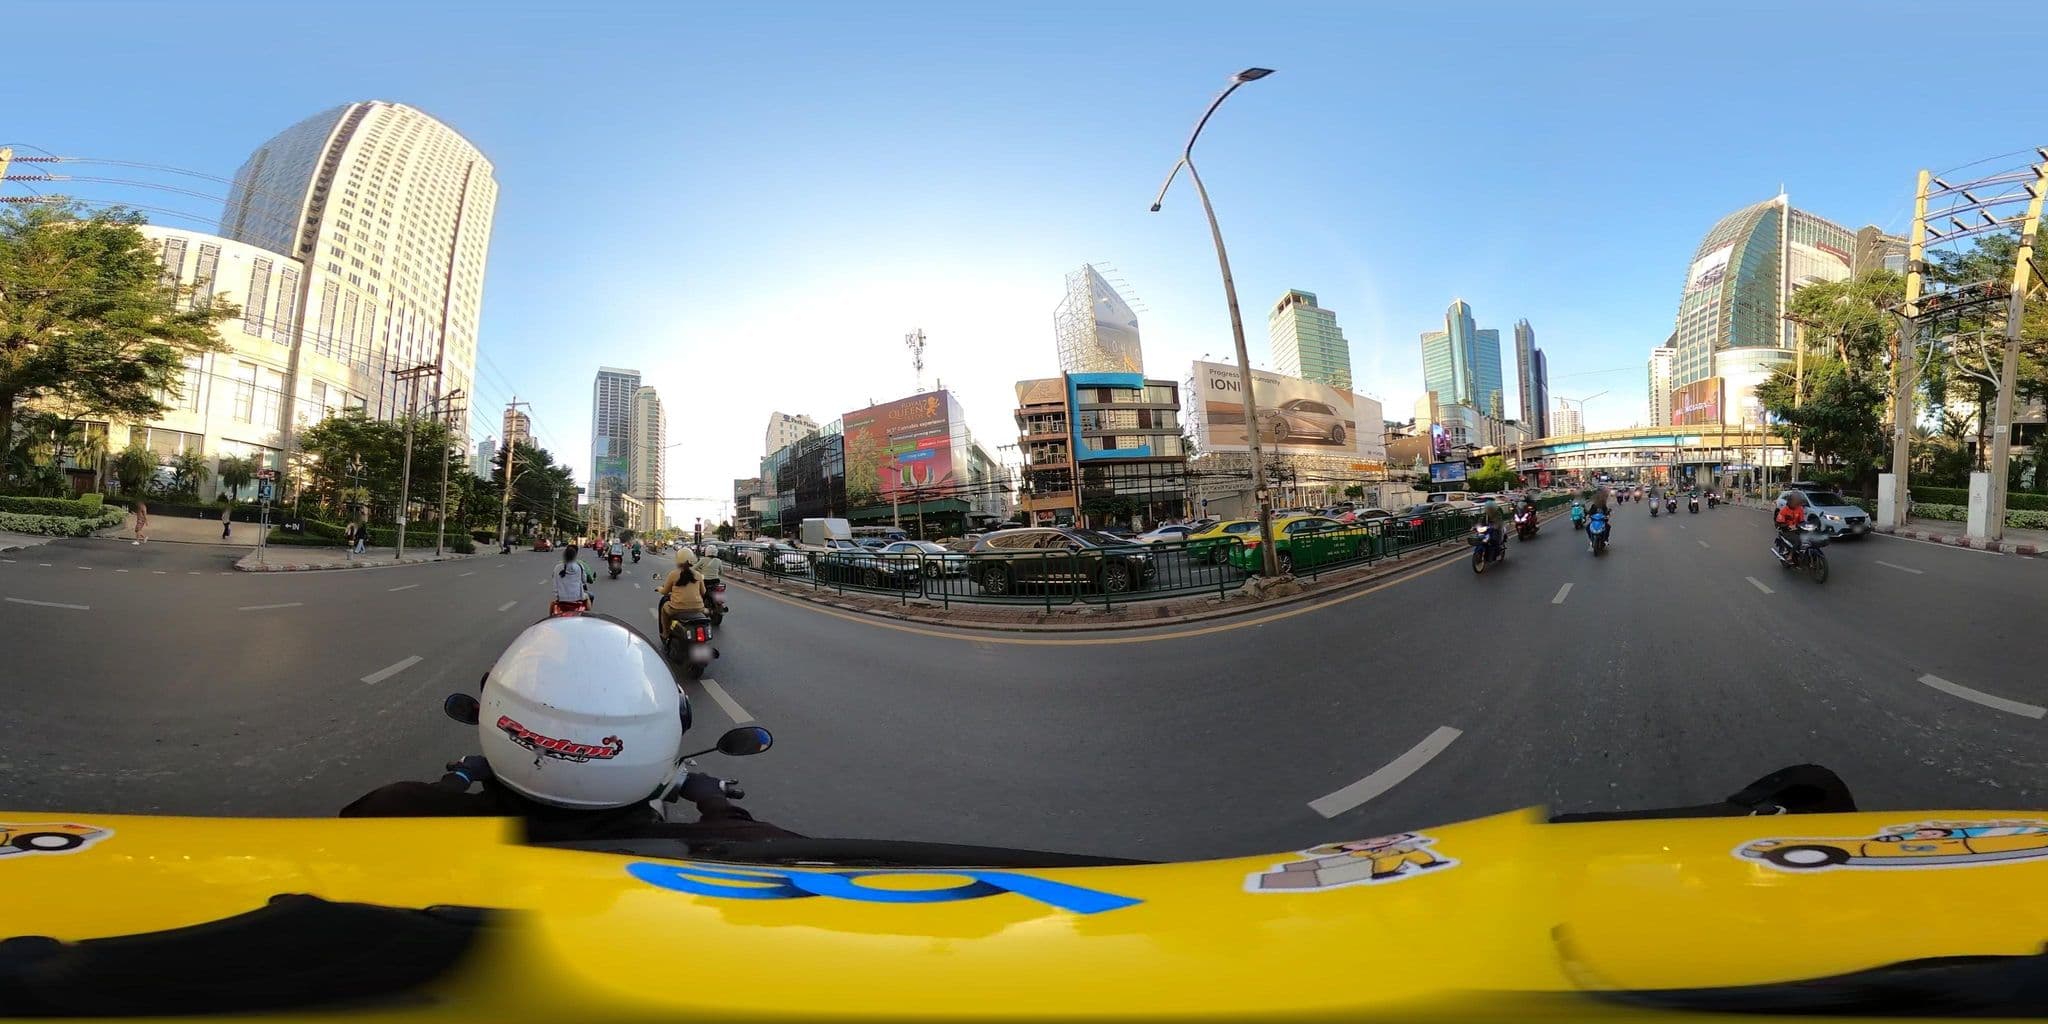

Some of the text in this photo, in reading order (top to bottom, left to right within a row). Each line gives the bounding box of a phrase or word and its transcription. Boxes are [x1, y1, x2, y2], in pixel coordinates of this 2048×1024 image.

[1209, 368, 1240, 378] Progress
[1210, 378, 1241, 392] IONI
[888, 400, 926, 419] QUEEN
[292, 523, 300, 531] IN
